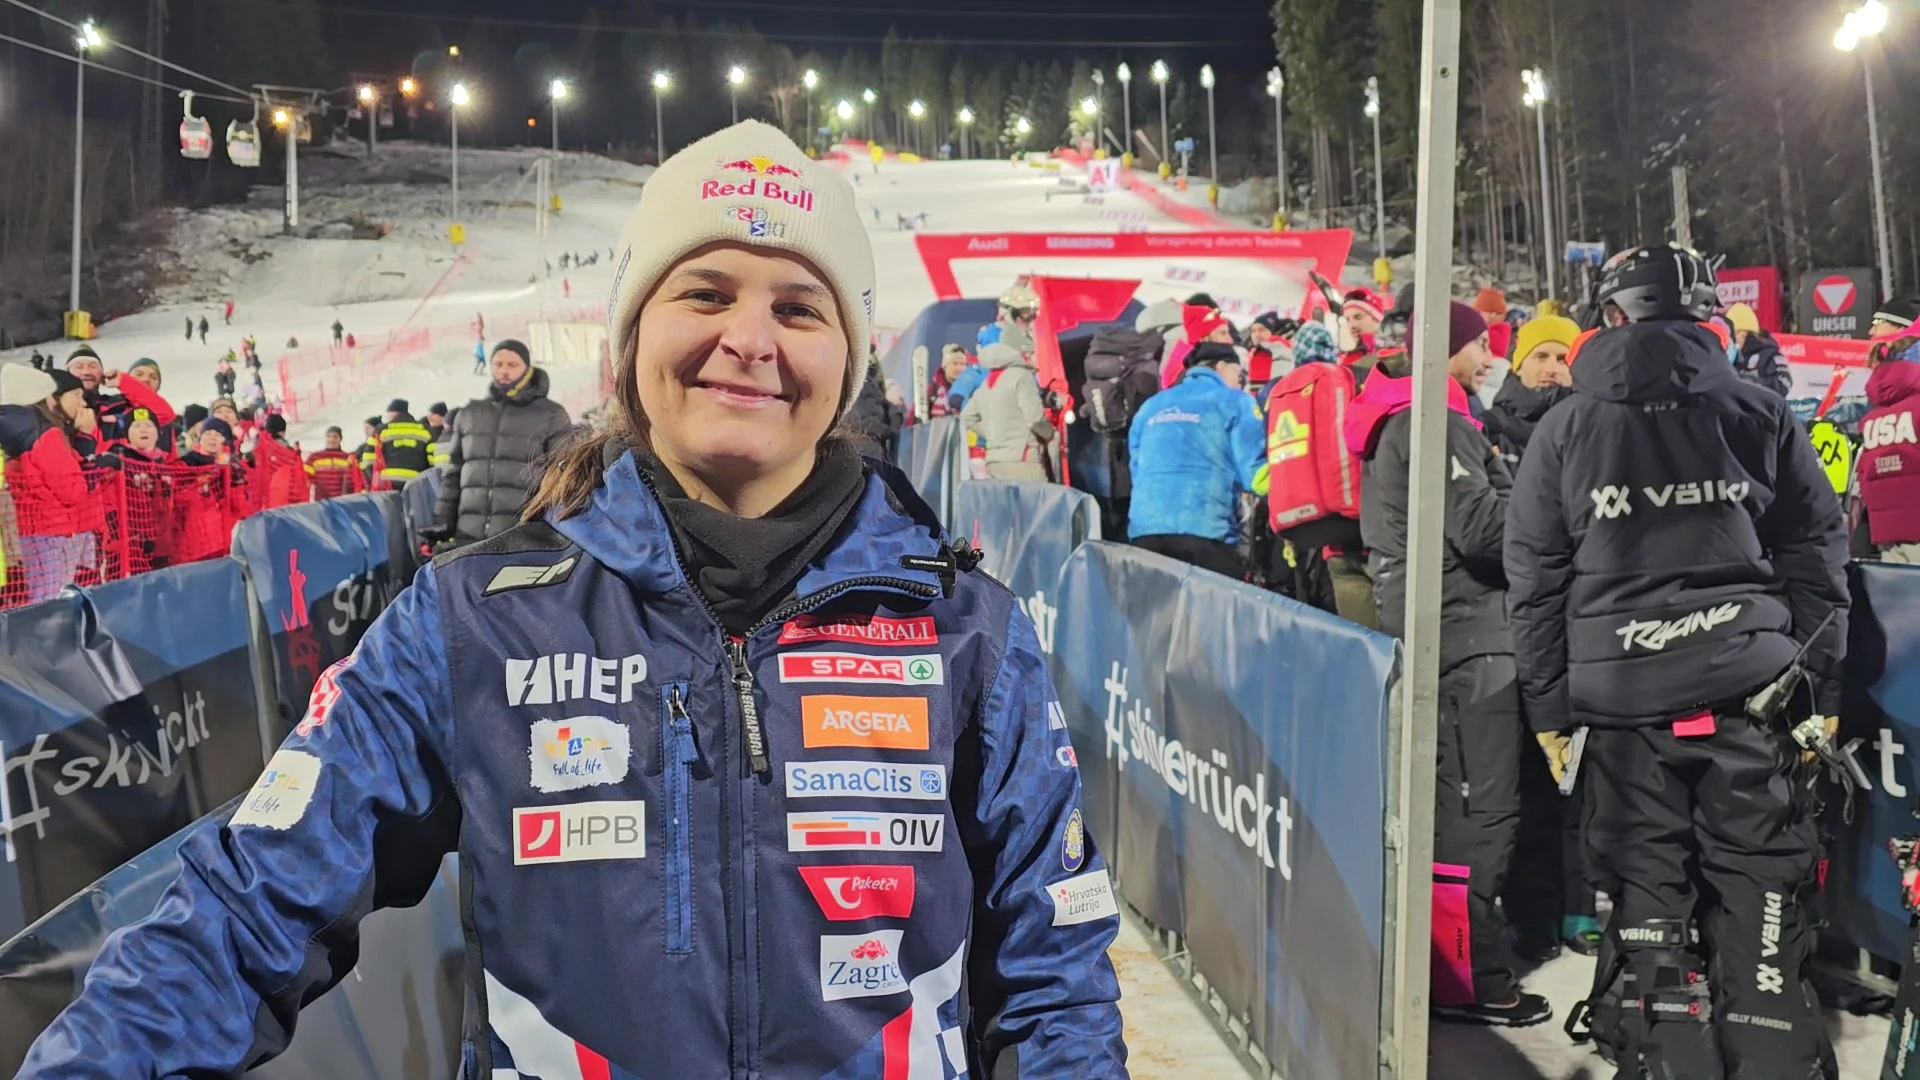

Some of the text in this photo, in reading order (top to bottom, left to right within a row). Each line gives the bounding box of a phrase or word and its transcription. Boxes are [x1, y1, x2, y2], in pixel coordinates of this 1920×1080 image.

[702, 178, 814, 212] Red Bull
[967, 237, 1009, 250] Audi
[1812, 316, 1857, 333] UNSER
[1863, 411, 1918, 450] USA
[818, 618, 930, 641] GENERALI
[1615, 601, 1742, 651] RACING
[553, 653, 648, 704] HEP
[811, 659, 901, 678] SPAR
[821, 708, 912, 737] ARGETA
[791, 768, 912, 793] SanaClis
[566, 815, 639, 849] HPB
[889, 818, 940, 847] OIV
[851, 876, 898, 892] Paket24
[1068, 883, 1107, 903] Hrvatska
[1068, 898, 1101, 916] Lutrija
[1456, 926, 1465, 961] ATOMIC
